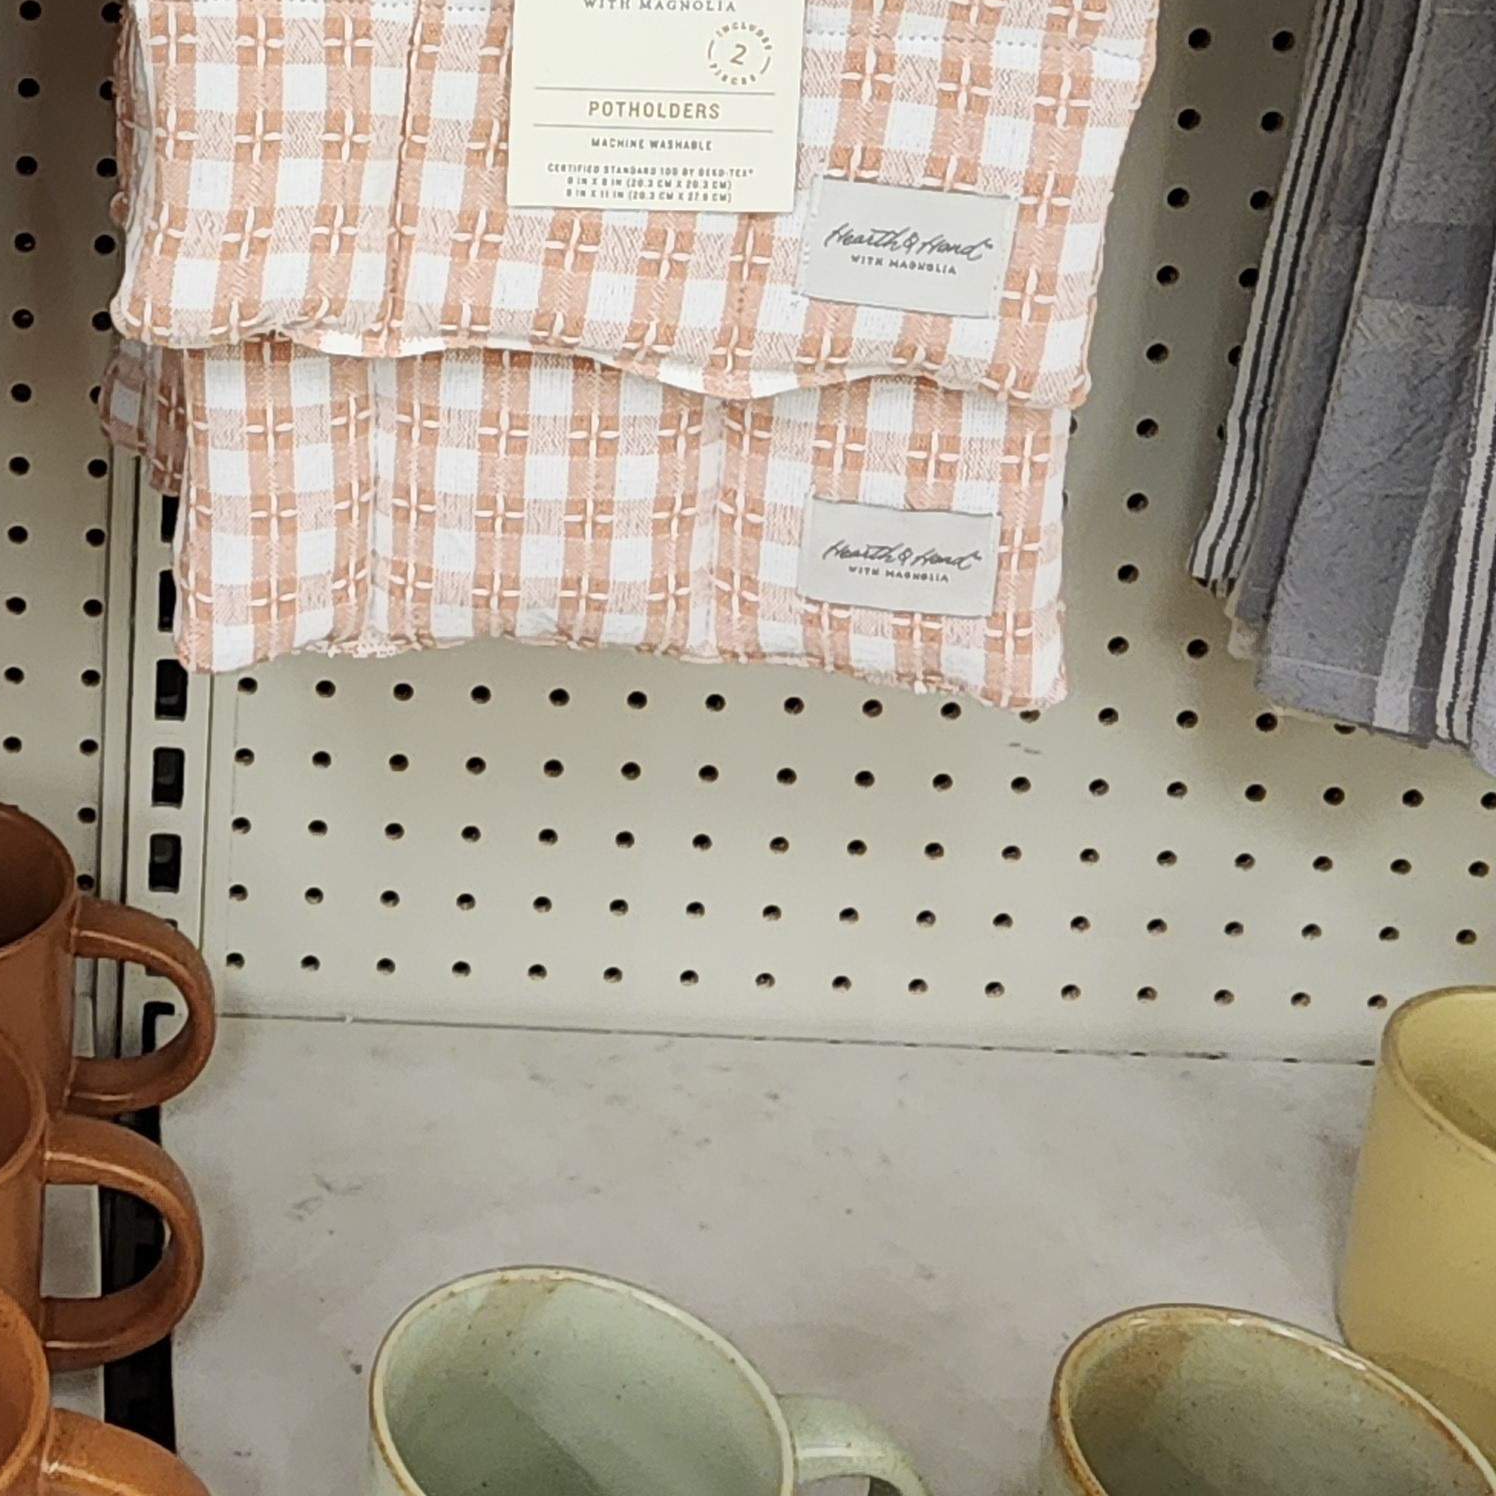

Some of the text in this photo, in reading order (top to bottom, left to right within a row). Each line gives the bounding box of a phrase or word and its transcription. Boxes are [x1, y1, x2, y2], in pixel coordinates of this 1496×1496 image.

[730, 43, 747, 65] 2
[587, 99, 721, 121] POTHOLDERS
[591, 137, 713, 151] MACHINE WASHABLE
[547, 163, 600, 174] CERTIFIED
[603, 164, 657, 175] STANDARD
[681, 166, 695, 177] BY
[577, 176, 588, 186] IN
[611, 178, 622, 187] IN
[657, 179, 672, 189] CM
[711, 180, 733, 190] CM)
[575, 188, 587, 198] IN
[612, 190, 624, 199] IN
[658, 191, 674, 201] CM
[711, 192, 733, 203] CM)
[823, 222, 910, 252] Hearth
[902, 230, 920, 255] &
[850, 254, 957, 275] WITH MAGNOLIA
[822, 539, 904, 564] Hearth
[897, 546, 913, 566] &
[848, 564, 949, 583] WITH MAGNOLIA
